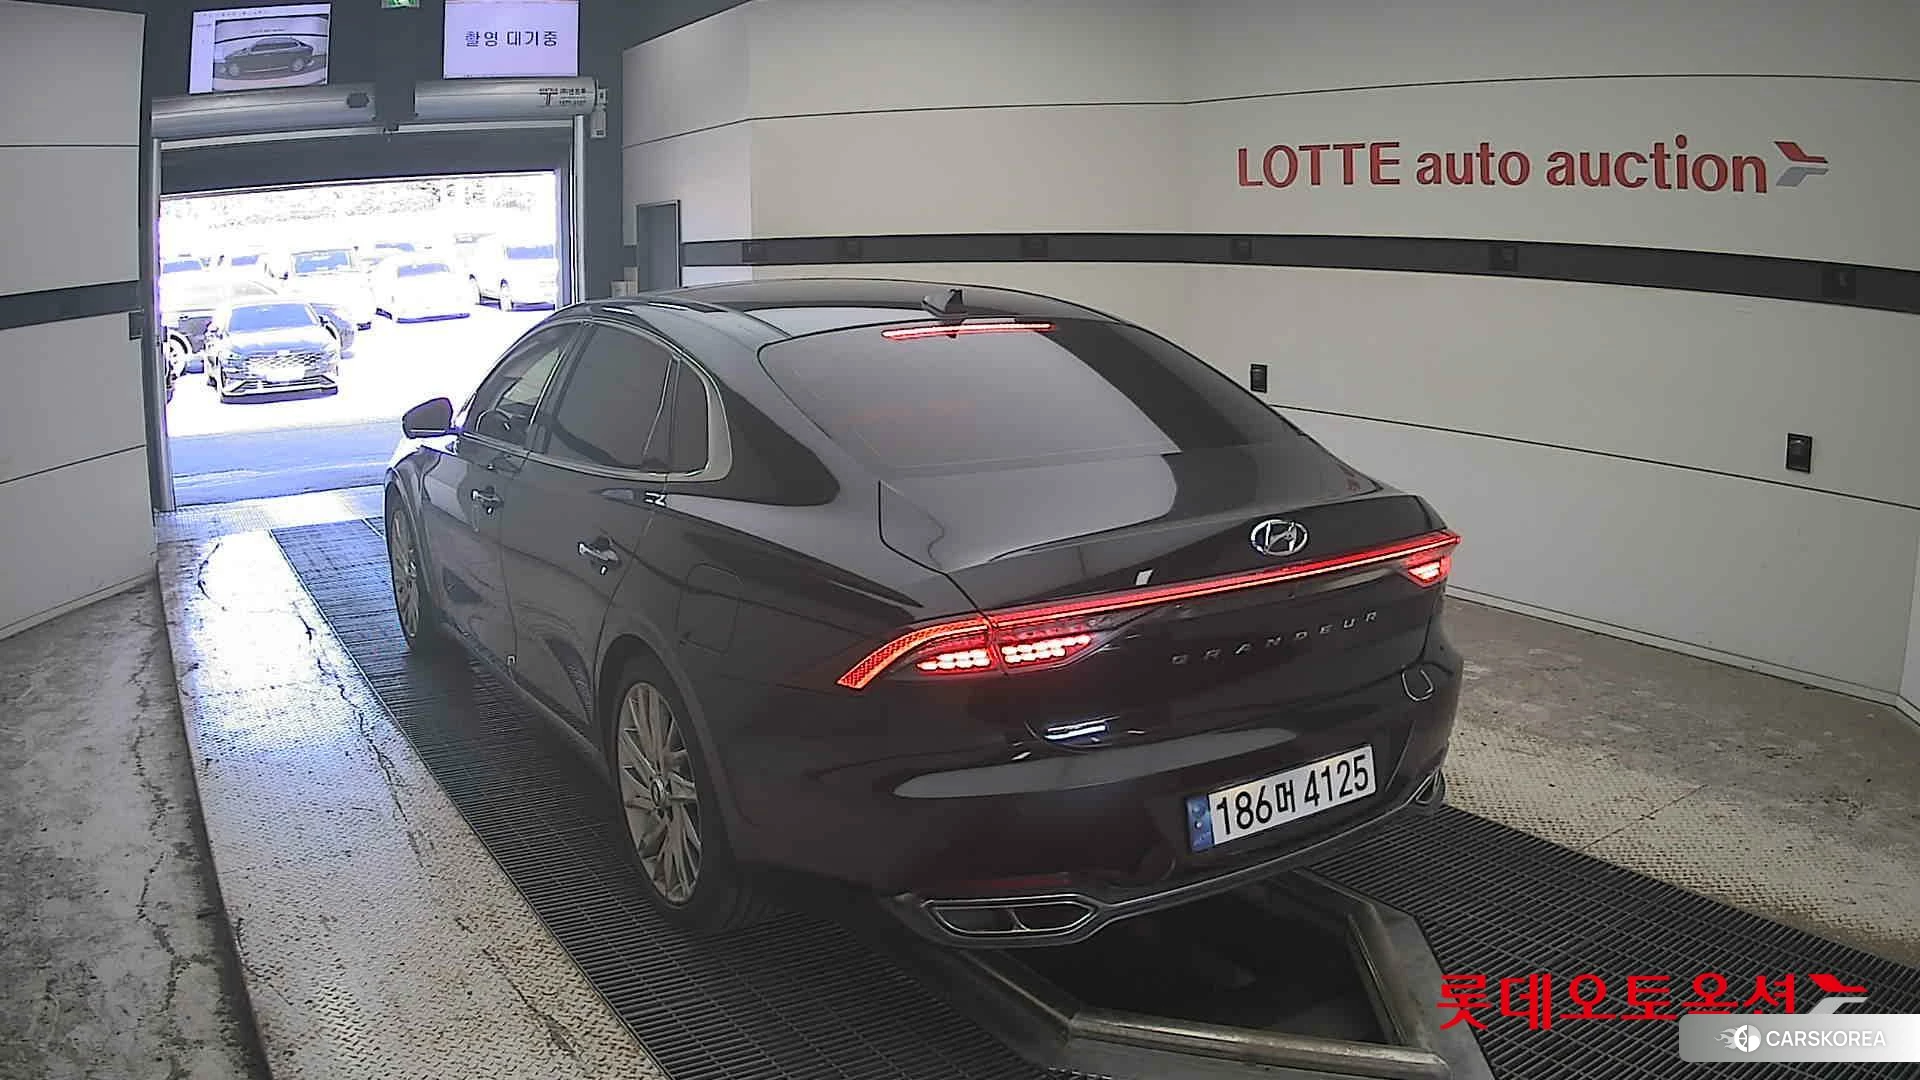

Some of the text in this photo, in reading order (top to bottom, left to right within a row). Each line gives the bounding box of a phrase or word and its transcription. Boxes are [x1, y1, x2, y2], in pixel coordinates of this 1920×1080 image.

[1237, 135, 1767, 193] LOTTE auto auction
[1171, 611, 1378, 664] GRANDEUR
[1216, 755, 1369, 835] 186머 4125
